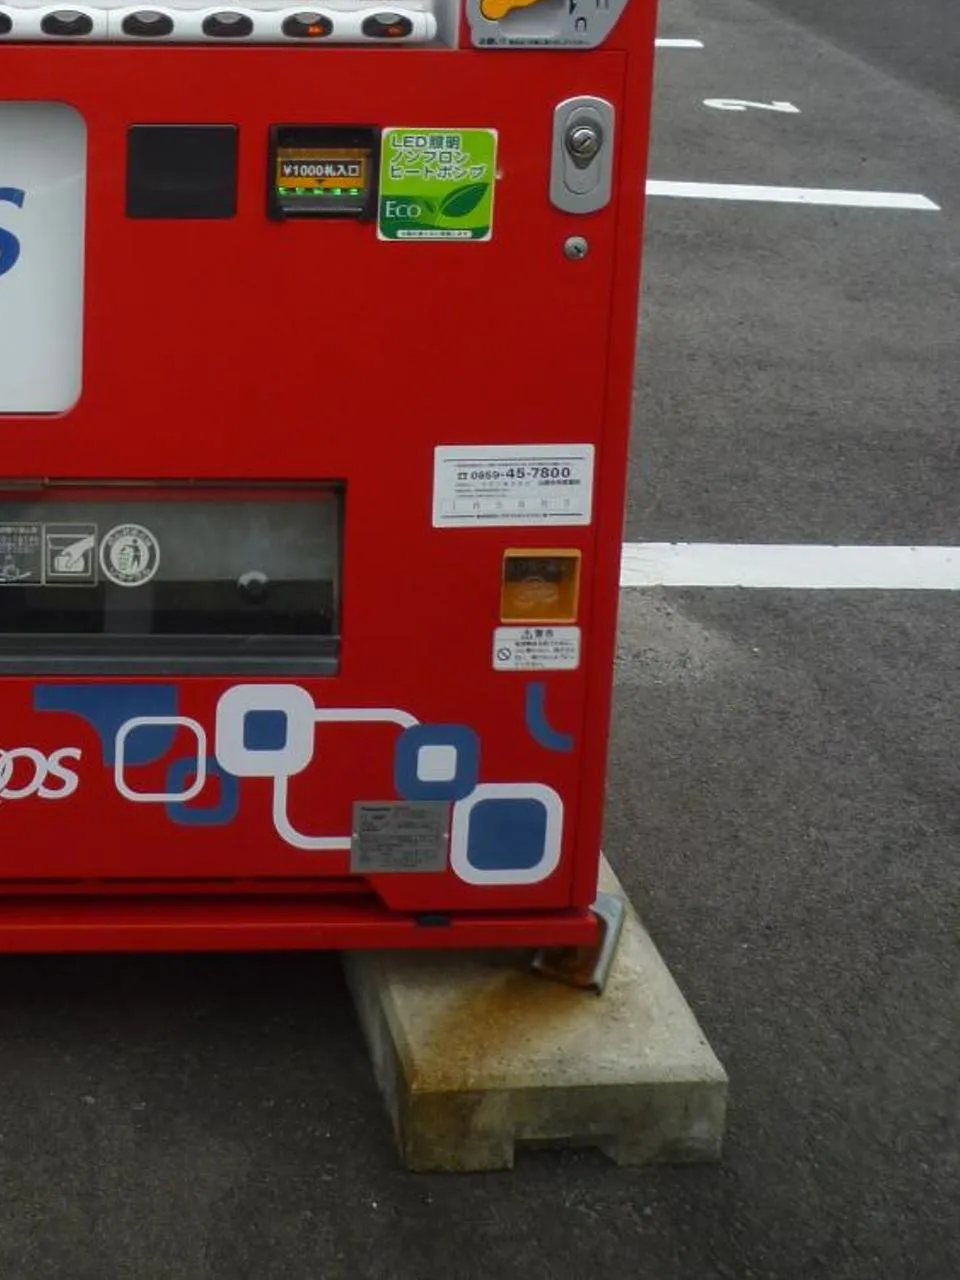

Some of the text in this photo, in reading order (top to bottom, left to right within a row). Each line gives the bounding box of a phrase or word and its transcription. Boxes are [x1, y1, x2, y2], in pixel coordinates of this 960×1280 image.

[390, 135, 462, 151] LED照明
[390, 151, 470, 165] ノンフロン
[390, 165, 486, 179] ヒートポンプ
